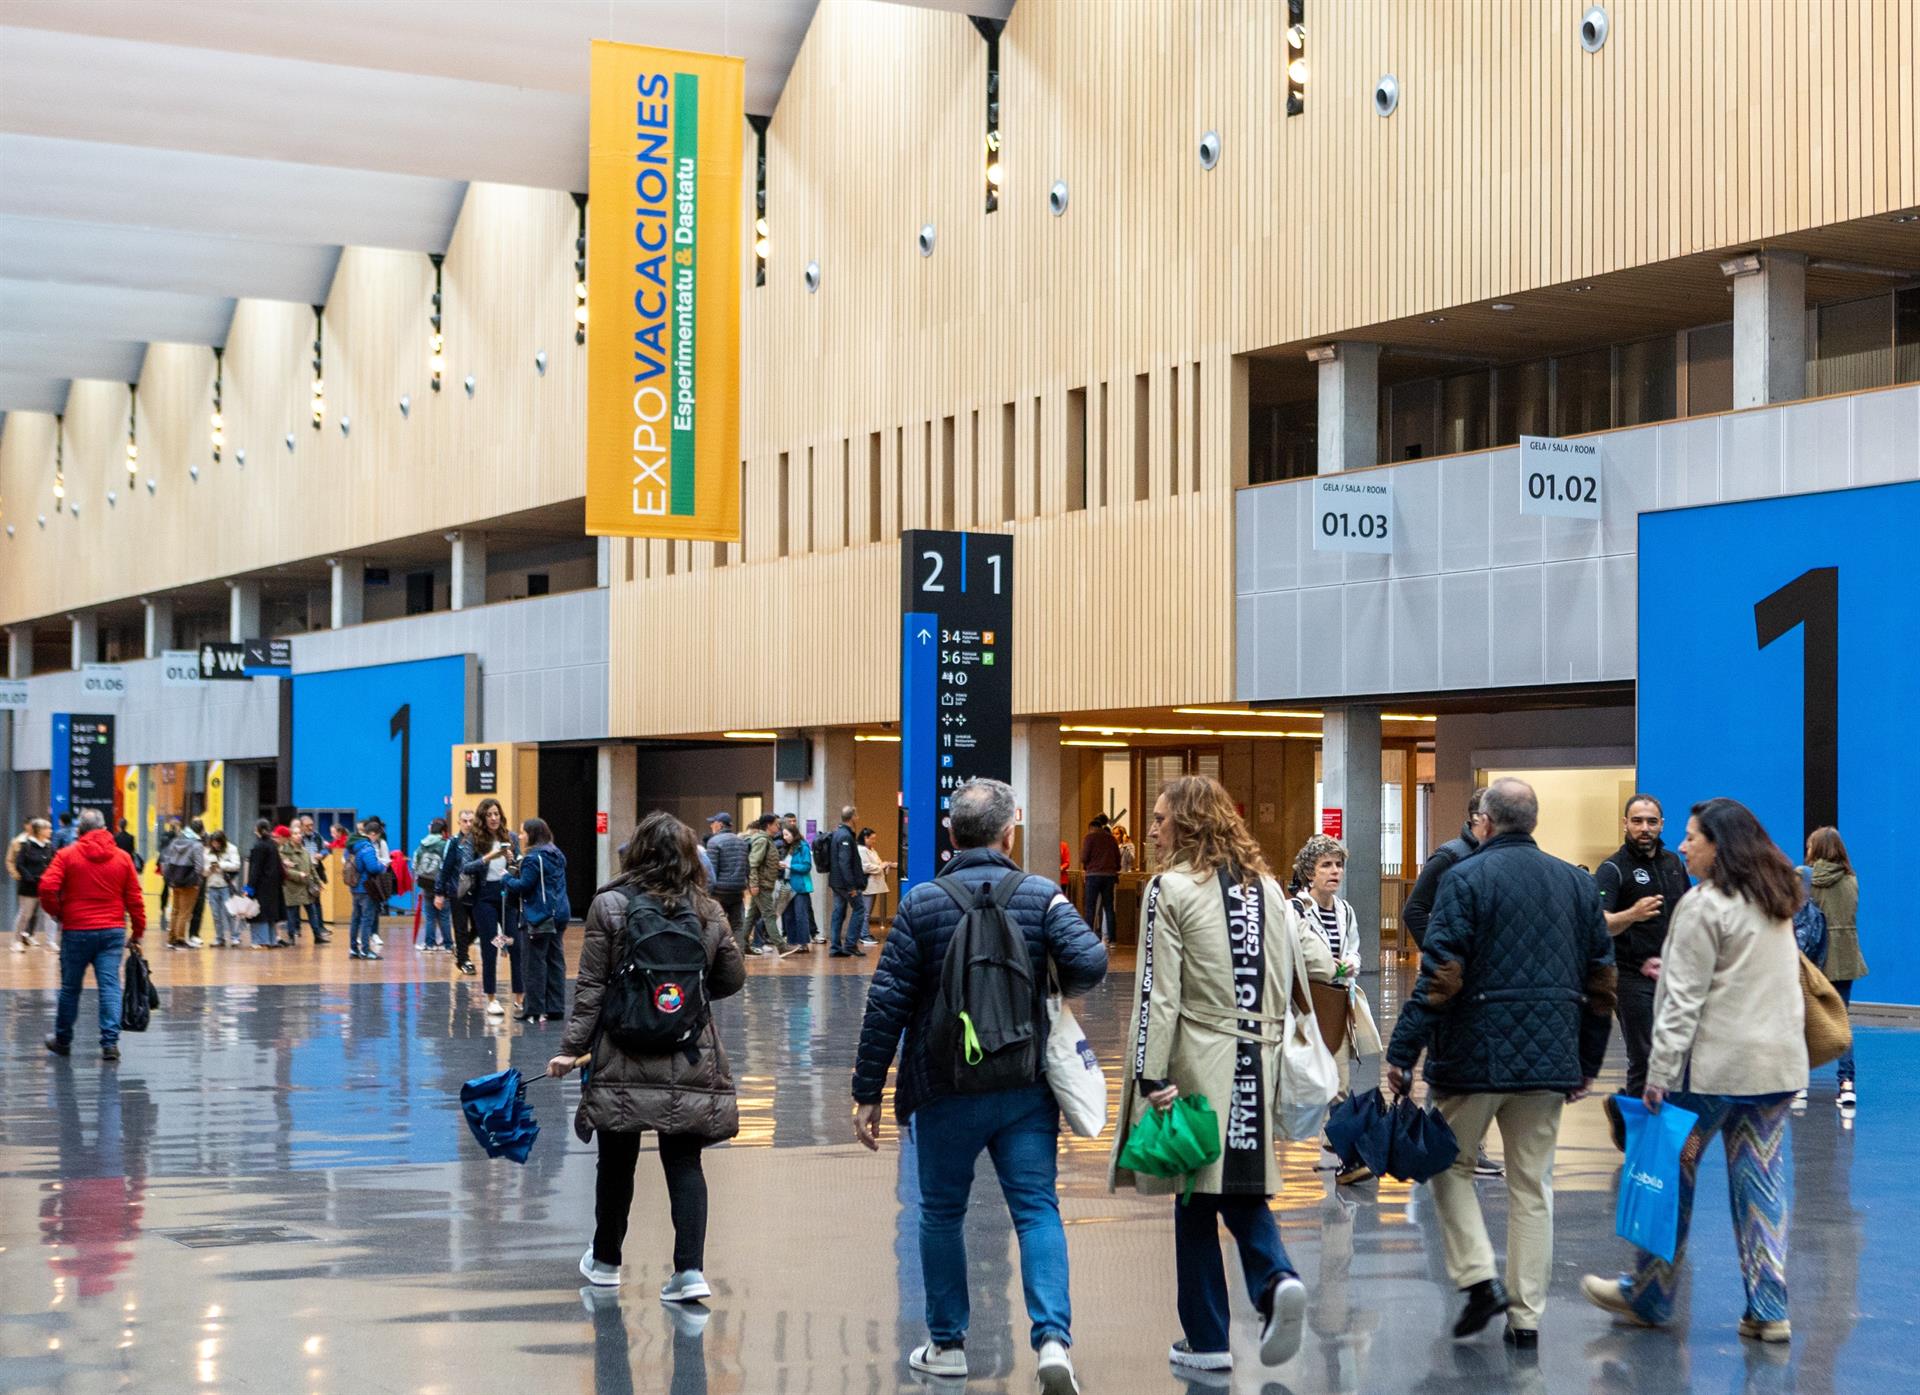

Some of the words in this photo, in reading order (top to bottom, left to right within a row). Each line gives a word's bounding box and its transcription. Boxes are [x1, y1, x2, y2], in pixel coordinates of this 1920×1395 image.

[675, 158, 694, 245] Dastatu
[675, 248, 692, 266] &
[673, 268, 695, 431] Esperimentatu
[1530, 441, 1546, 451] GELA
[1552, 443, 1569, 452] SALA
[1574, 444, 1596, 455] ROOM
[1323, 483, 1339, 492] GELA
[1346, 484, 1361, 494] SALA
[1367, 485, 1387, 495] ROOM
[1528, 472, 1597, 503] 01.02
[1322, 512, 1388, 539] 01.03
[922, 551, 944, 592] 2
[987, 554, 1001, 594] 1
[167, 667, 198, 681] 01.0
[1754, 566, 1839, 855] 1
[390, 703, 410, 857] 1
[1146, 951, 1152, 964] BY
[1142, 966, 1153, 992] LOVE
[1140, 1000, 1149, 1028] LOLA
[1138, 1029, 1146, 1044] BY
[1136, 1045, 1145, 1073] LOVE
[1239, 1081, 1257, 1150] STYLE
